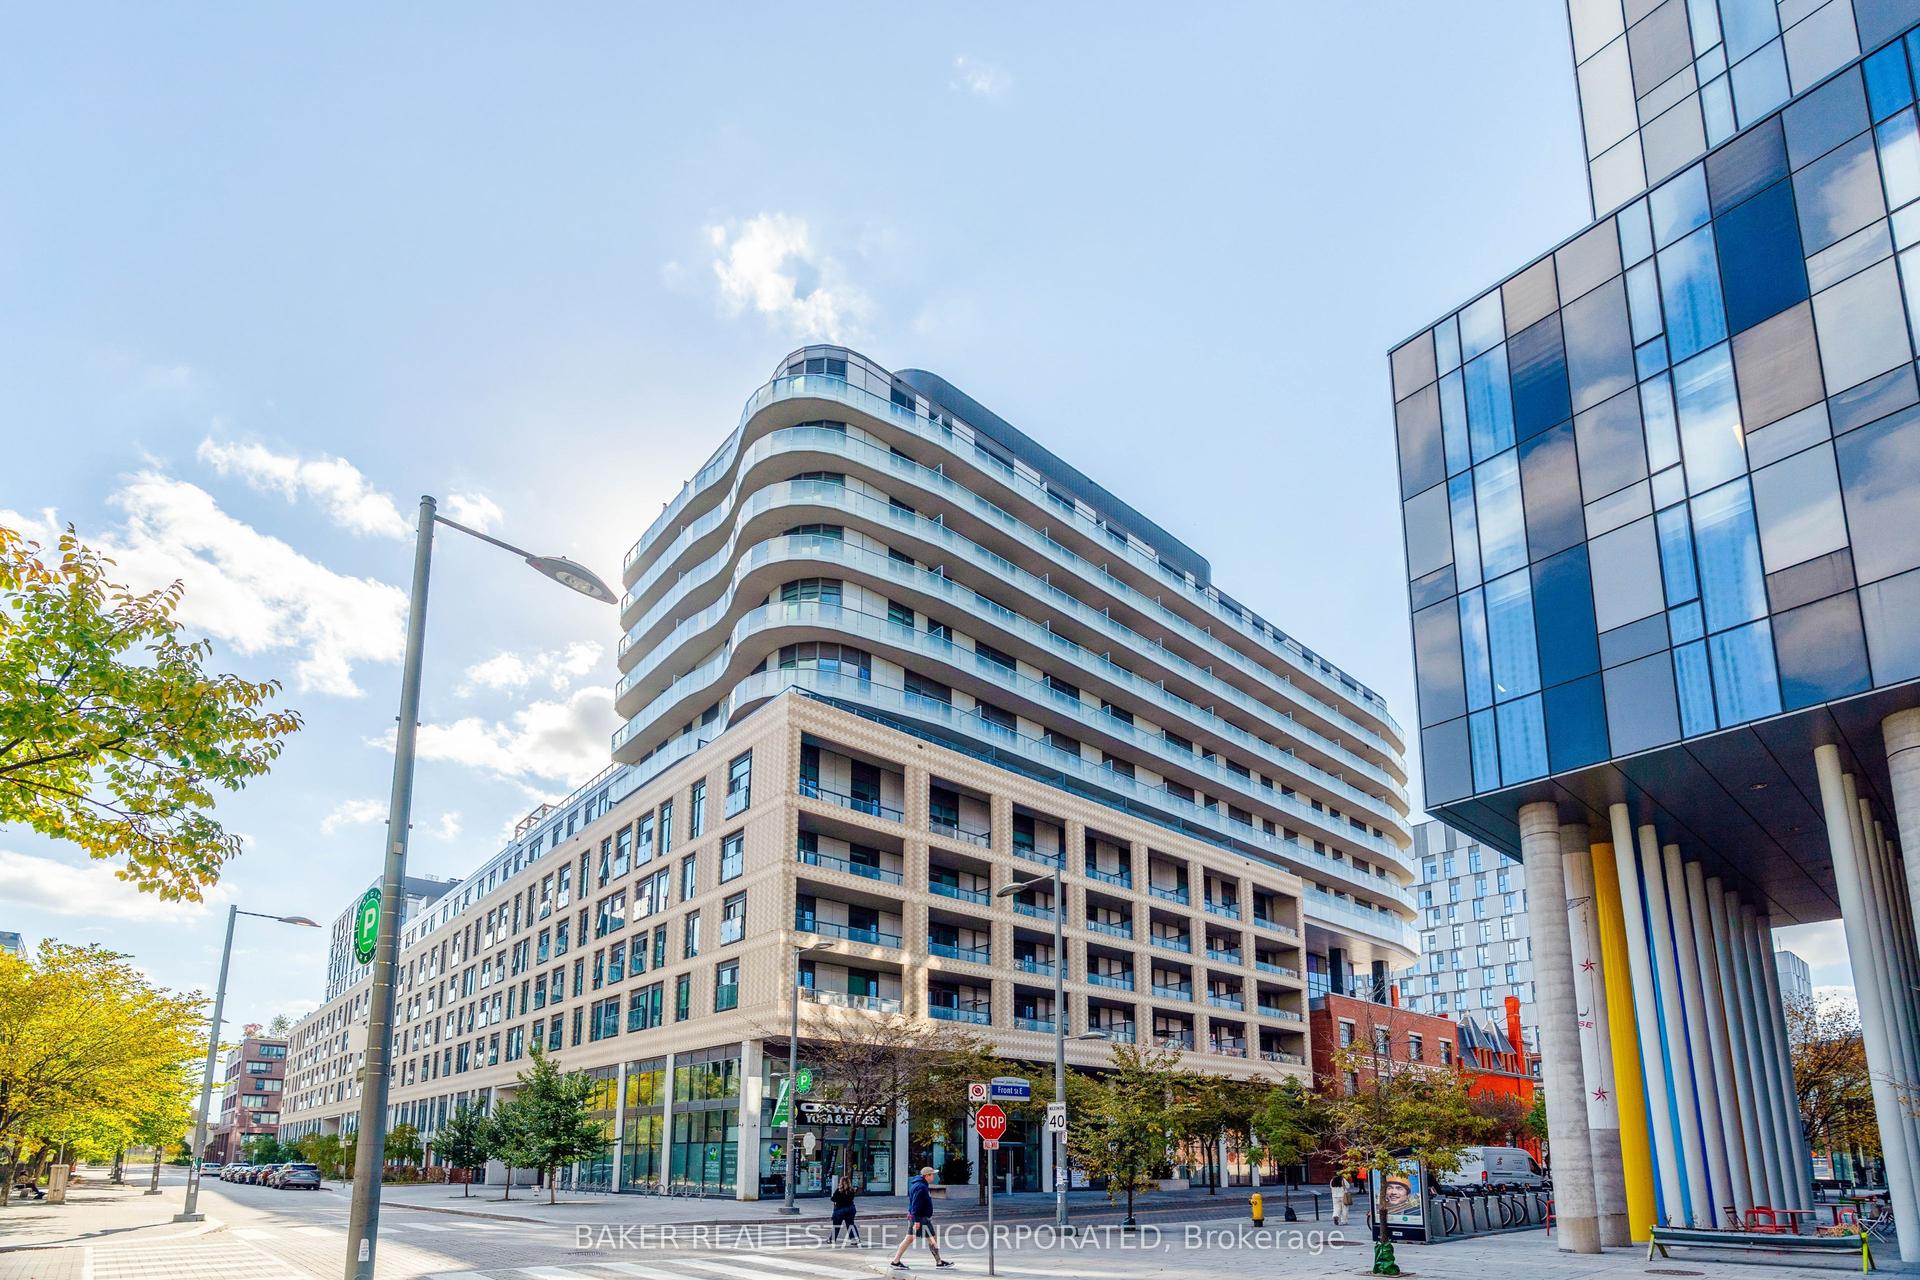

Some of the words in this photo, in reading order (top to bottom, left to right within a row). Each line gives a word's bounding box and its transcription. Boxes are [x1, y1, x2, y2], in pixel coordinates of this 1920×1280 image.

[363, 907, 376, 938] P
[997, 1086, 1013, 1095] Front
[805, 1113, 833, 1125] YOGA
[978, 1115, 1004, 1129] STOP
[1049, 1114, 1065, 1128] 40
